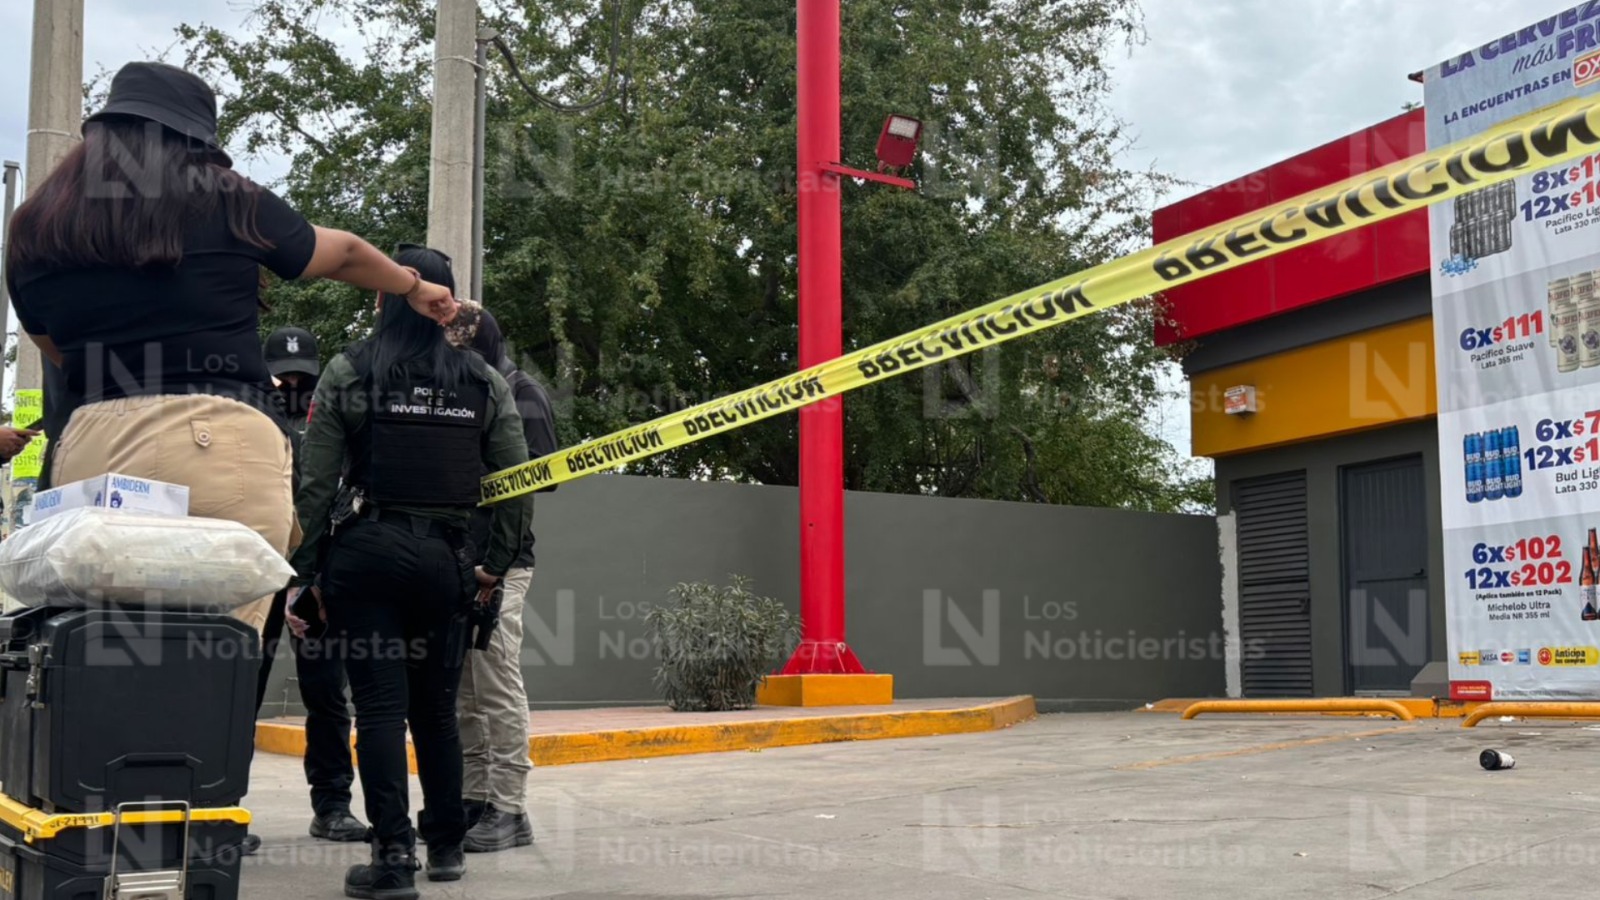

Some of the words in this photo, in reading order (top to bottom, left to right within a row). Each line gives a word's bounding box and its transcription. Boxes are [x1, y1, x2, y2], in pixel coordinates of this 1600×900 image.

[1512, 44, 1556, 75] más
[1556, 18, 1600, 59] FR
[1443, 111, 1459, 125] LA
[1461, 77, 1549, 119] ENCUENTRAS
[1552, 68, 1571, 85] EN
[1520, 180, 1600, 222] 12x$1
[1554, 225, 1572, 235] Lata
[1459, 309, 1543, 351] 6x$111
[1506, 341, 1535, 354] Suave
[1481, 360, 1496, 370] Lata
[1513, 353, 1525, 361] ml
[391, 404, 475, 419] INVESTIGACIÓN
[1556, 469, 1578, 482] Bud
[111, 477, 150, 495] AMBIDERM
[1555, 484, 1577, 495] Lata
[1579, 480, 1598, 491] 330
[1472, 535, 1562, 565] 6x$102
[1464, 560, 1572, 589] 12x$202
[1487, 602, 1527, 612] Michelob
[1529, 601, 1551, 609] Ultra
